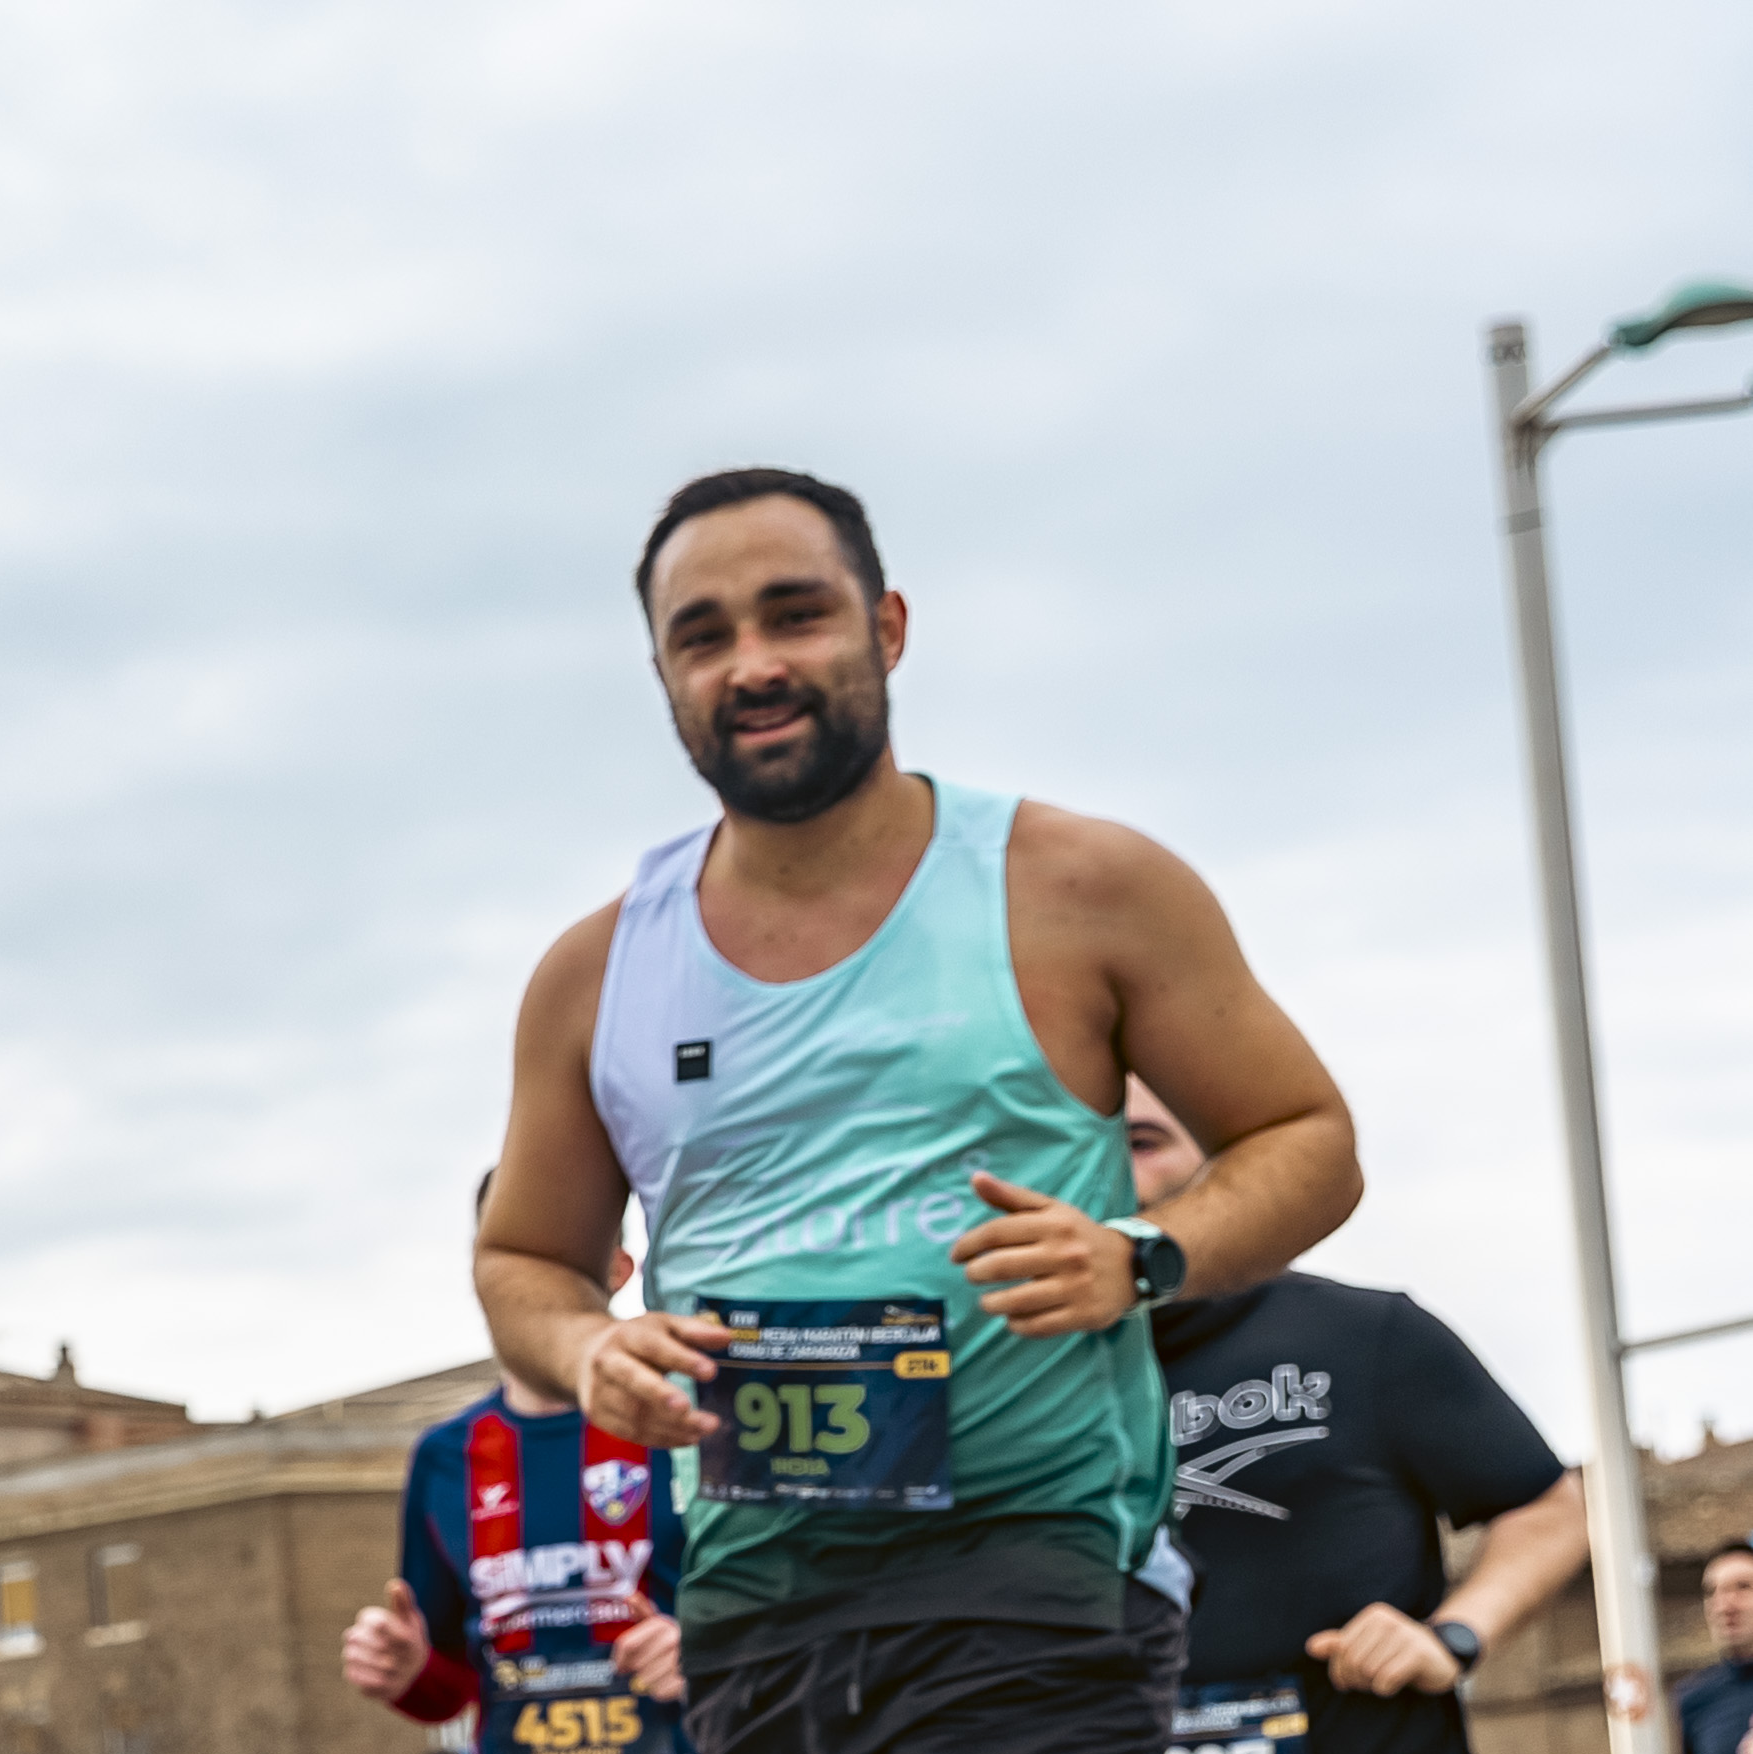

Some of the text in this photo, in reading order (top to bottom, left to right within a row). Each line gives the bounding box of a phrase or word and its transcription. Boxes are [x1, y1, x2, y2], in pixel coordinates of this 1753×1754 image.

[734, 1382, 871, 1455] 913
[469, 1539, 654, 1599] SIMPLY
[514, 1696, 642, 1748] 4515
